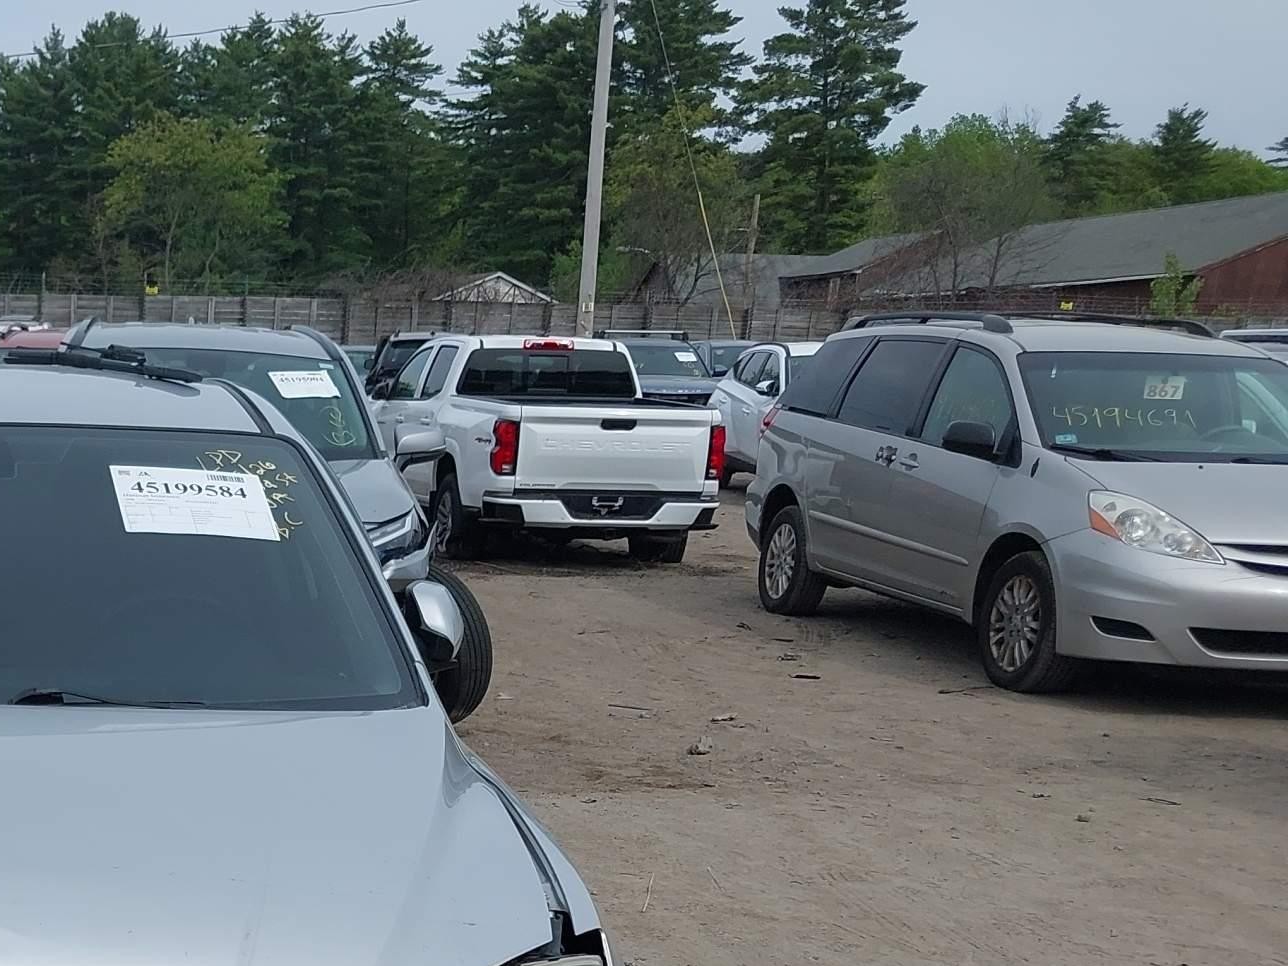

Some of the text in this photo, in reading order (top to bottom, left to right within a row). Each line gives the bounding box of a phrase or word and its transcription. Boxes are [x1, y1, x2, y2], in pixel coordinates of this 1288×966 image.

[1146, 384, 1181, 398] 867
[1052, 406, 1198, 429] 45194691
[543, 437, 692, 453] CHEVROLET
[130, 481, 248, 499] 45199584
